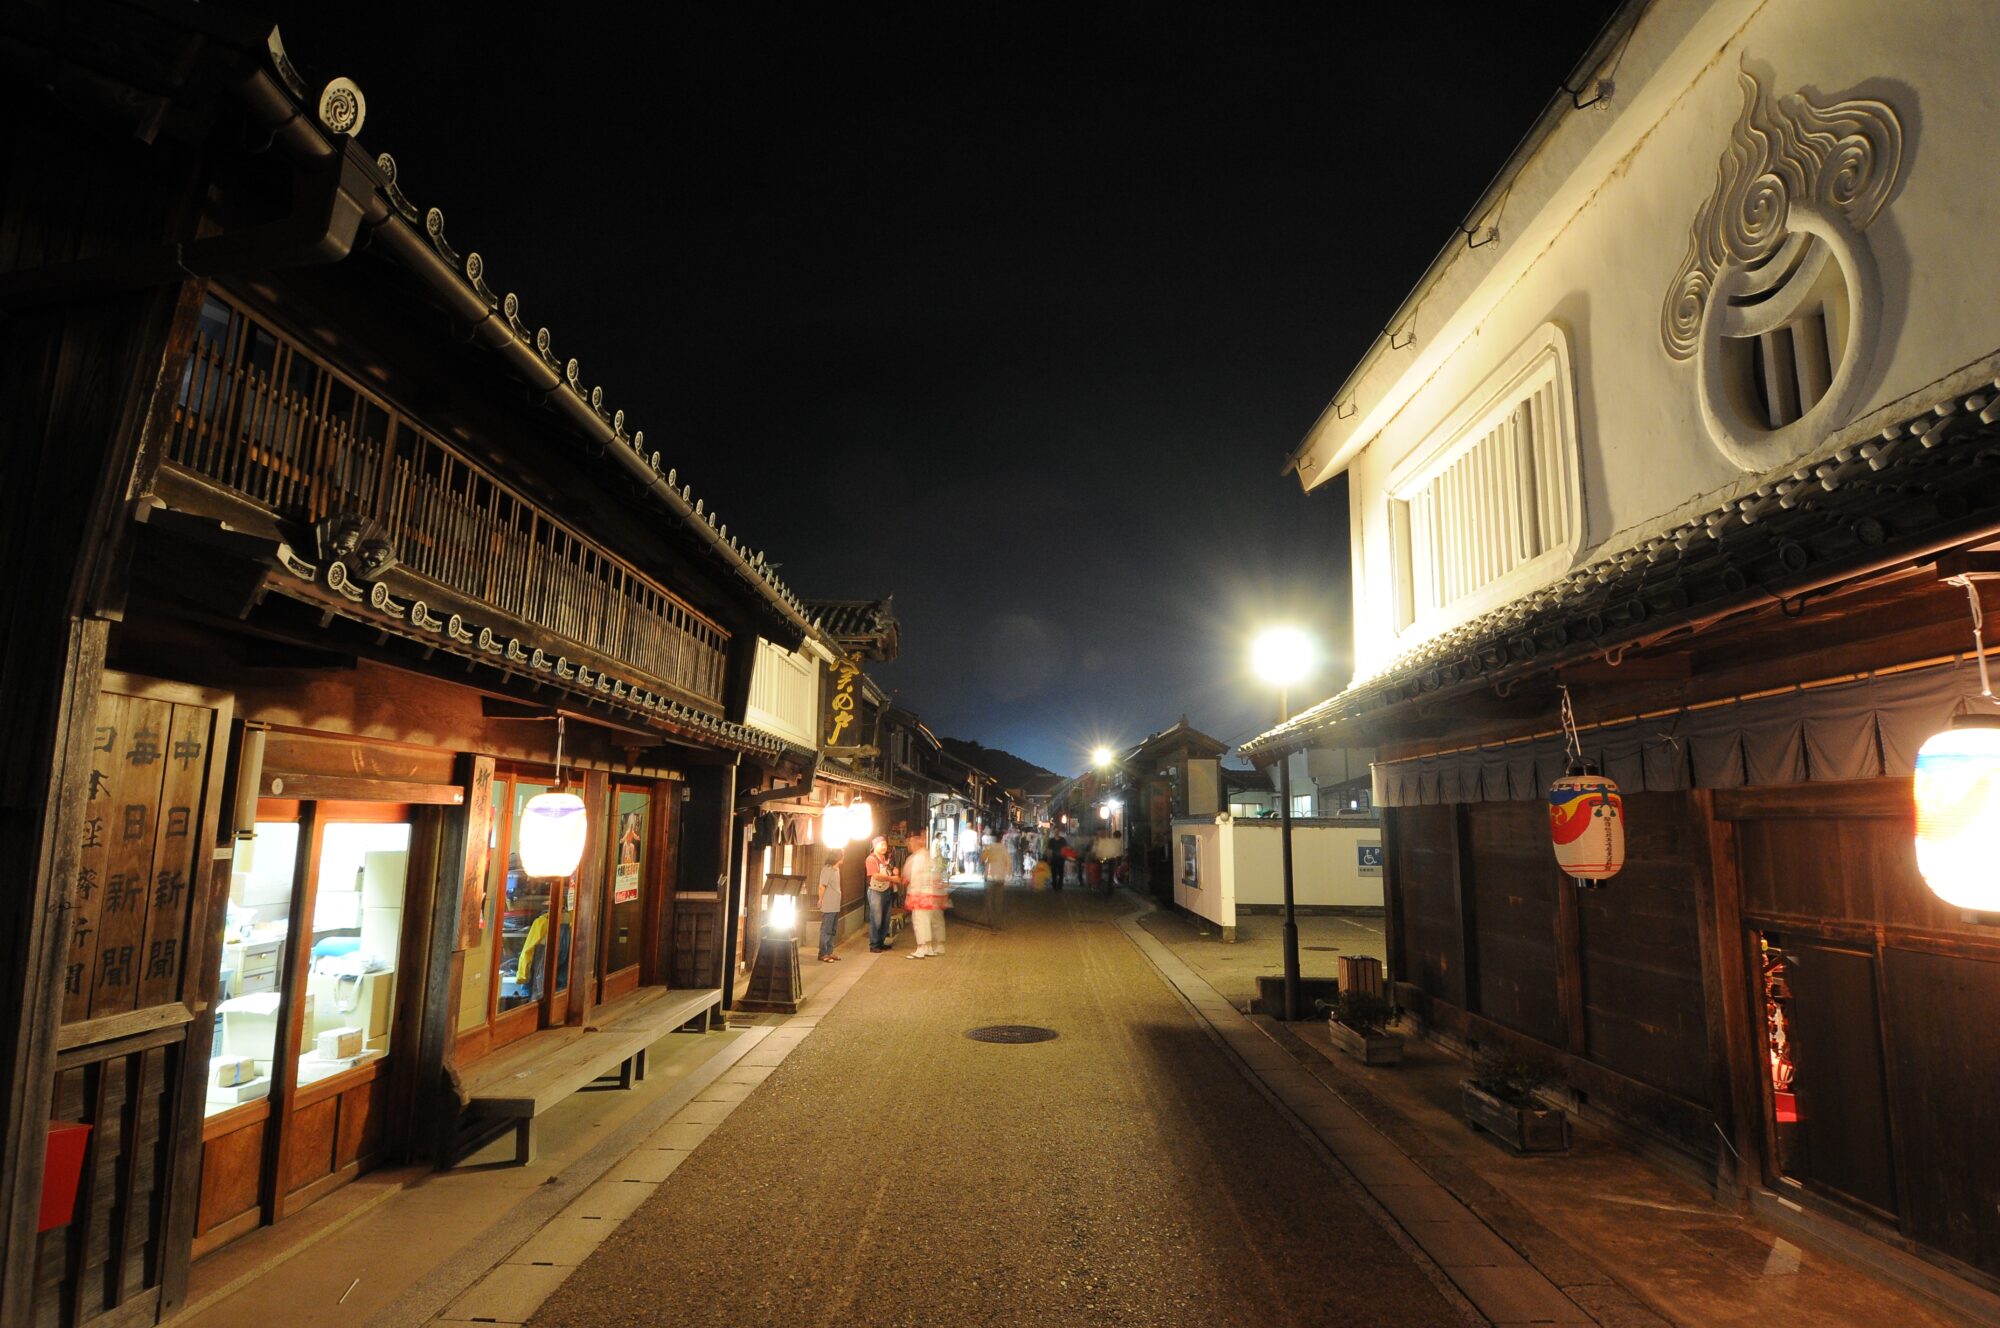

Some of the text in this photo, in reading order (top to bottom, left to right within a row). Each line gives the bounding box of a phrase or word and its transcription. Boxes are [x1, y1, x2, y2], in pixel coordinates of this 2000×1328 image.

[98, 727, 161, 989] 毎日新聞
[145, 731, 202, 981] 中日新聞
